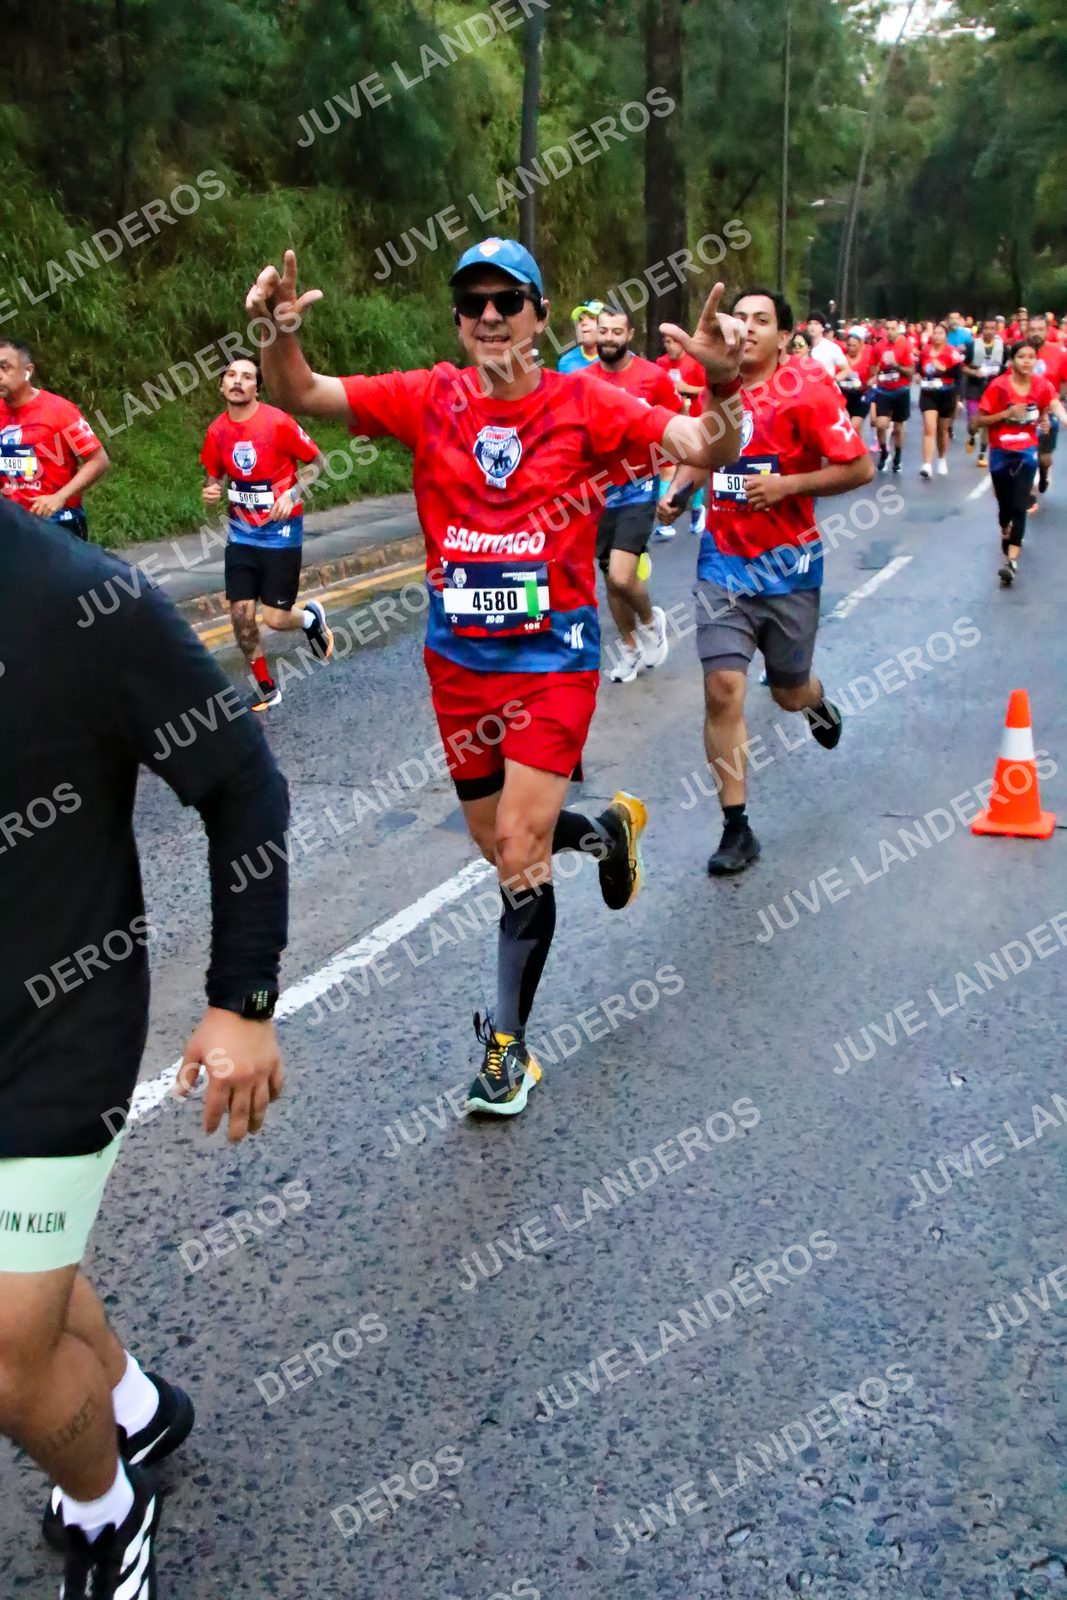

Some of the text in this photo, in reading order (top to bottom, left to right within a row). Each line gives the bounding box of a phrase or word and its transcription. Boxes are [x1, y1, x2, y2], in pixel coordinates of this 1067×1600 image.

[444, 525, 546, 554] SANTIAGO
[472, 590, 518, 611] 4580
[26, 1210, 66, 1233] KLEIN
